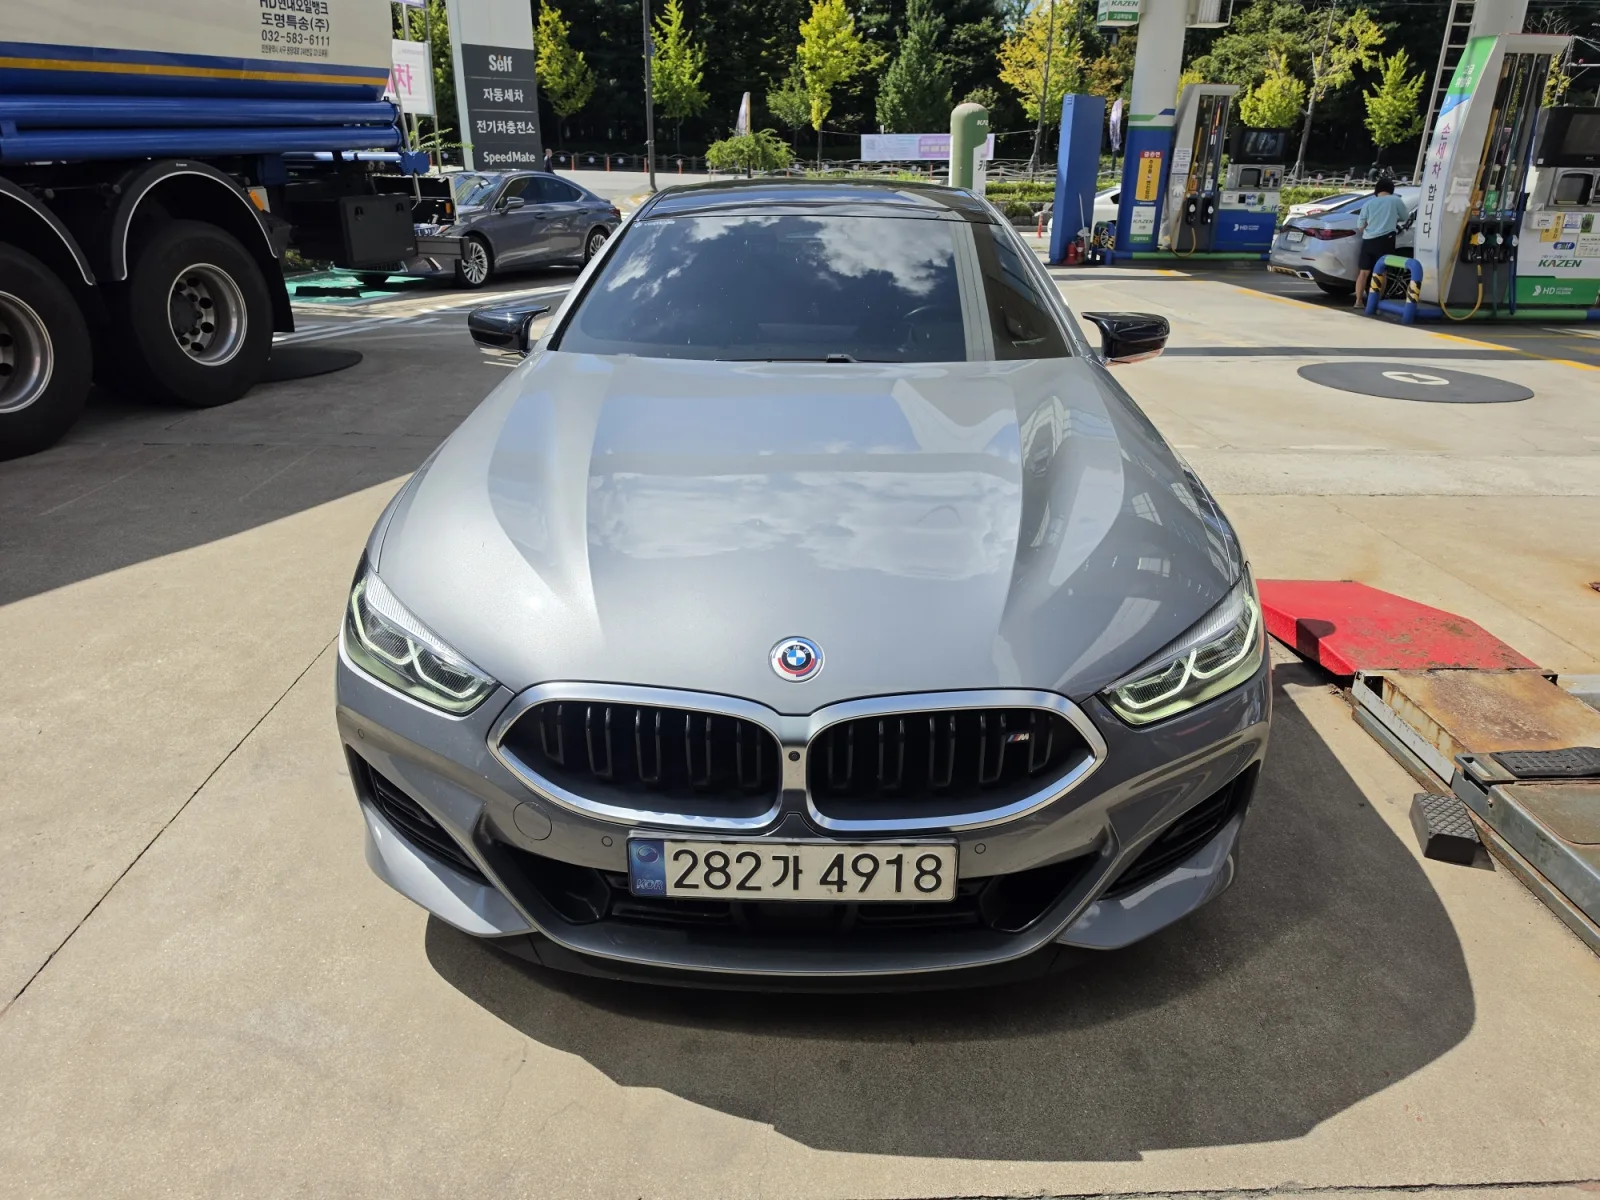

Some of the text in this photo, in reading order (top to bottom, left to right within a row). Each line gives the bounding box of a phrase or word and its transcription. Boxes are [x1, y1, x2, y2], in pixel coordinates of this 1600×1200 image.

[261, 12, 330, 32] 도명특송(주)
[261, 29, 330, 46] 032-583-6111
[488, 54, 513, 72] Self
[483, 88, 524, 103] 자동세차
[476, 120, 536, 134] 전기차충전소
[483, 151, 536, 165] SpeedMate
[1538, 260, 1582, 268] KAZEN
[1542, 286, 1556, 295] HD
[785, 645, 810, 654] BMW
[672, 848, 943, 894] 282가 4918
[636, 878, 664, 890] KOR
